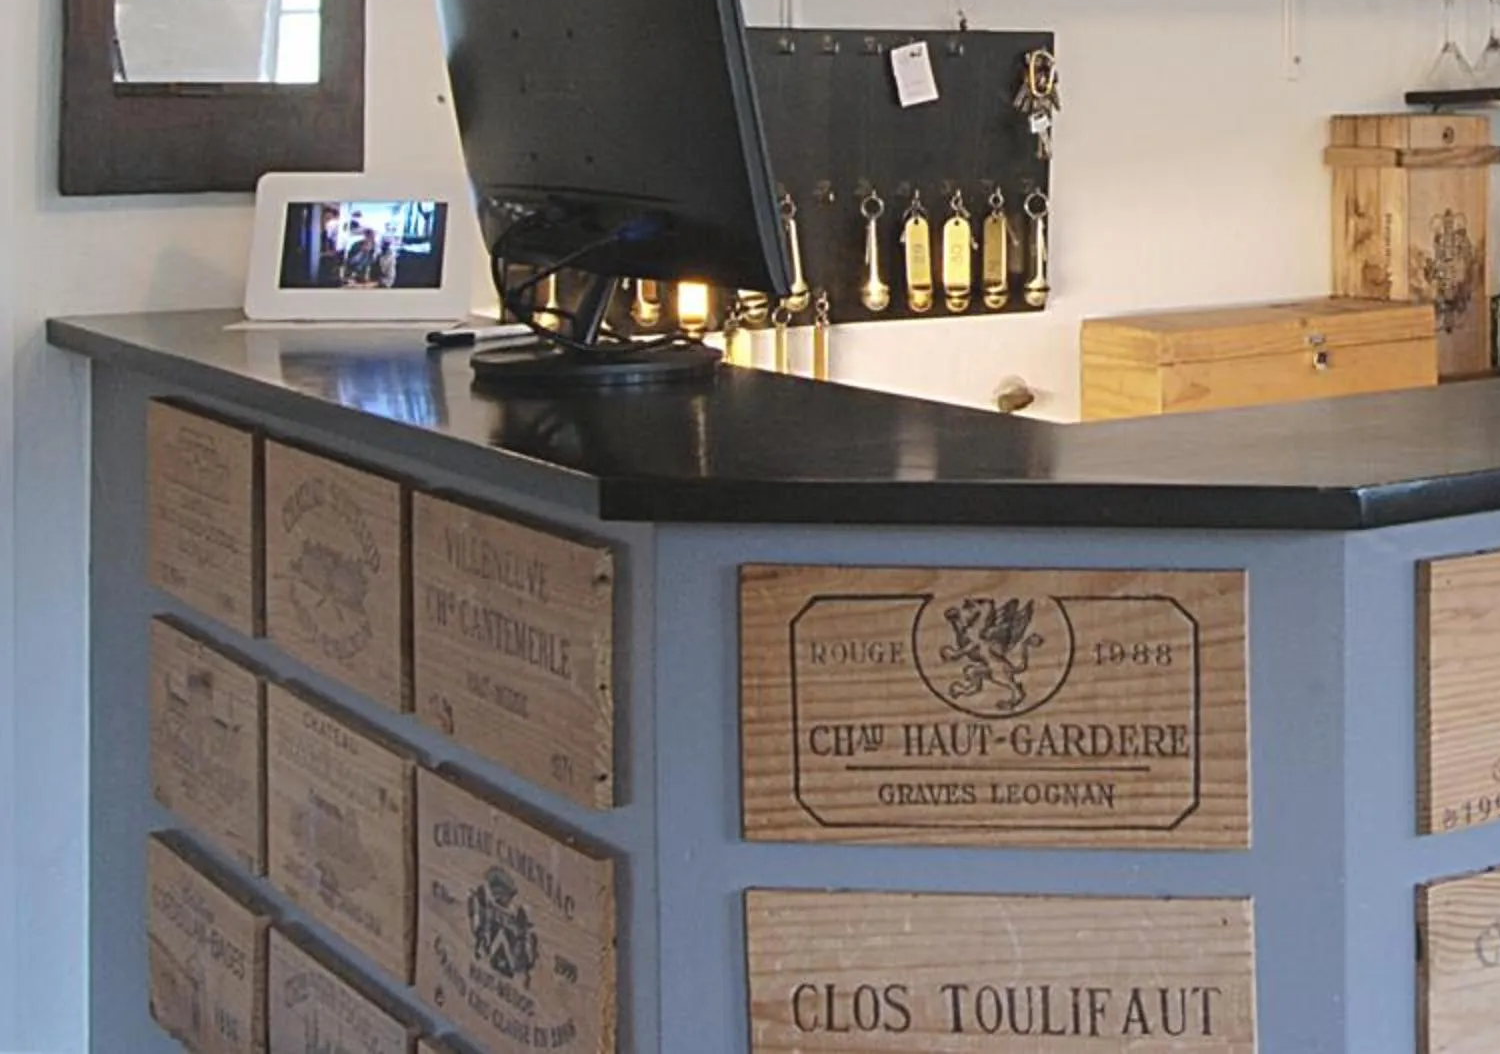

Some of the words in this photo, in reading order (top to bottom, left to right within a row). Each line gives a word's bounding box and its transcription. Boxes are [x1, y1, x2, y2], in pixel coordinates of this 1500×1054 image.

[810, 640, 907, 667] ROUGE
[1093, 639, 1174, 667] 1988
[903, 722, 1191, 759] HAUT-GARDERE
[878, 782, 978, 808] GRAVES
[991, 783, 1117, 809] LEOGNAN
[791, 982, 912, 1034] CLOS
[940, 983, 1223, 1038] TOULIFAUT
